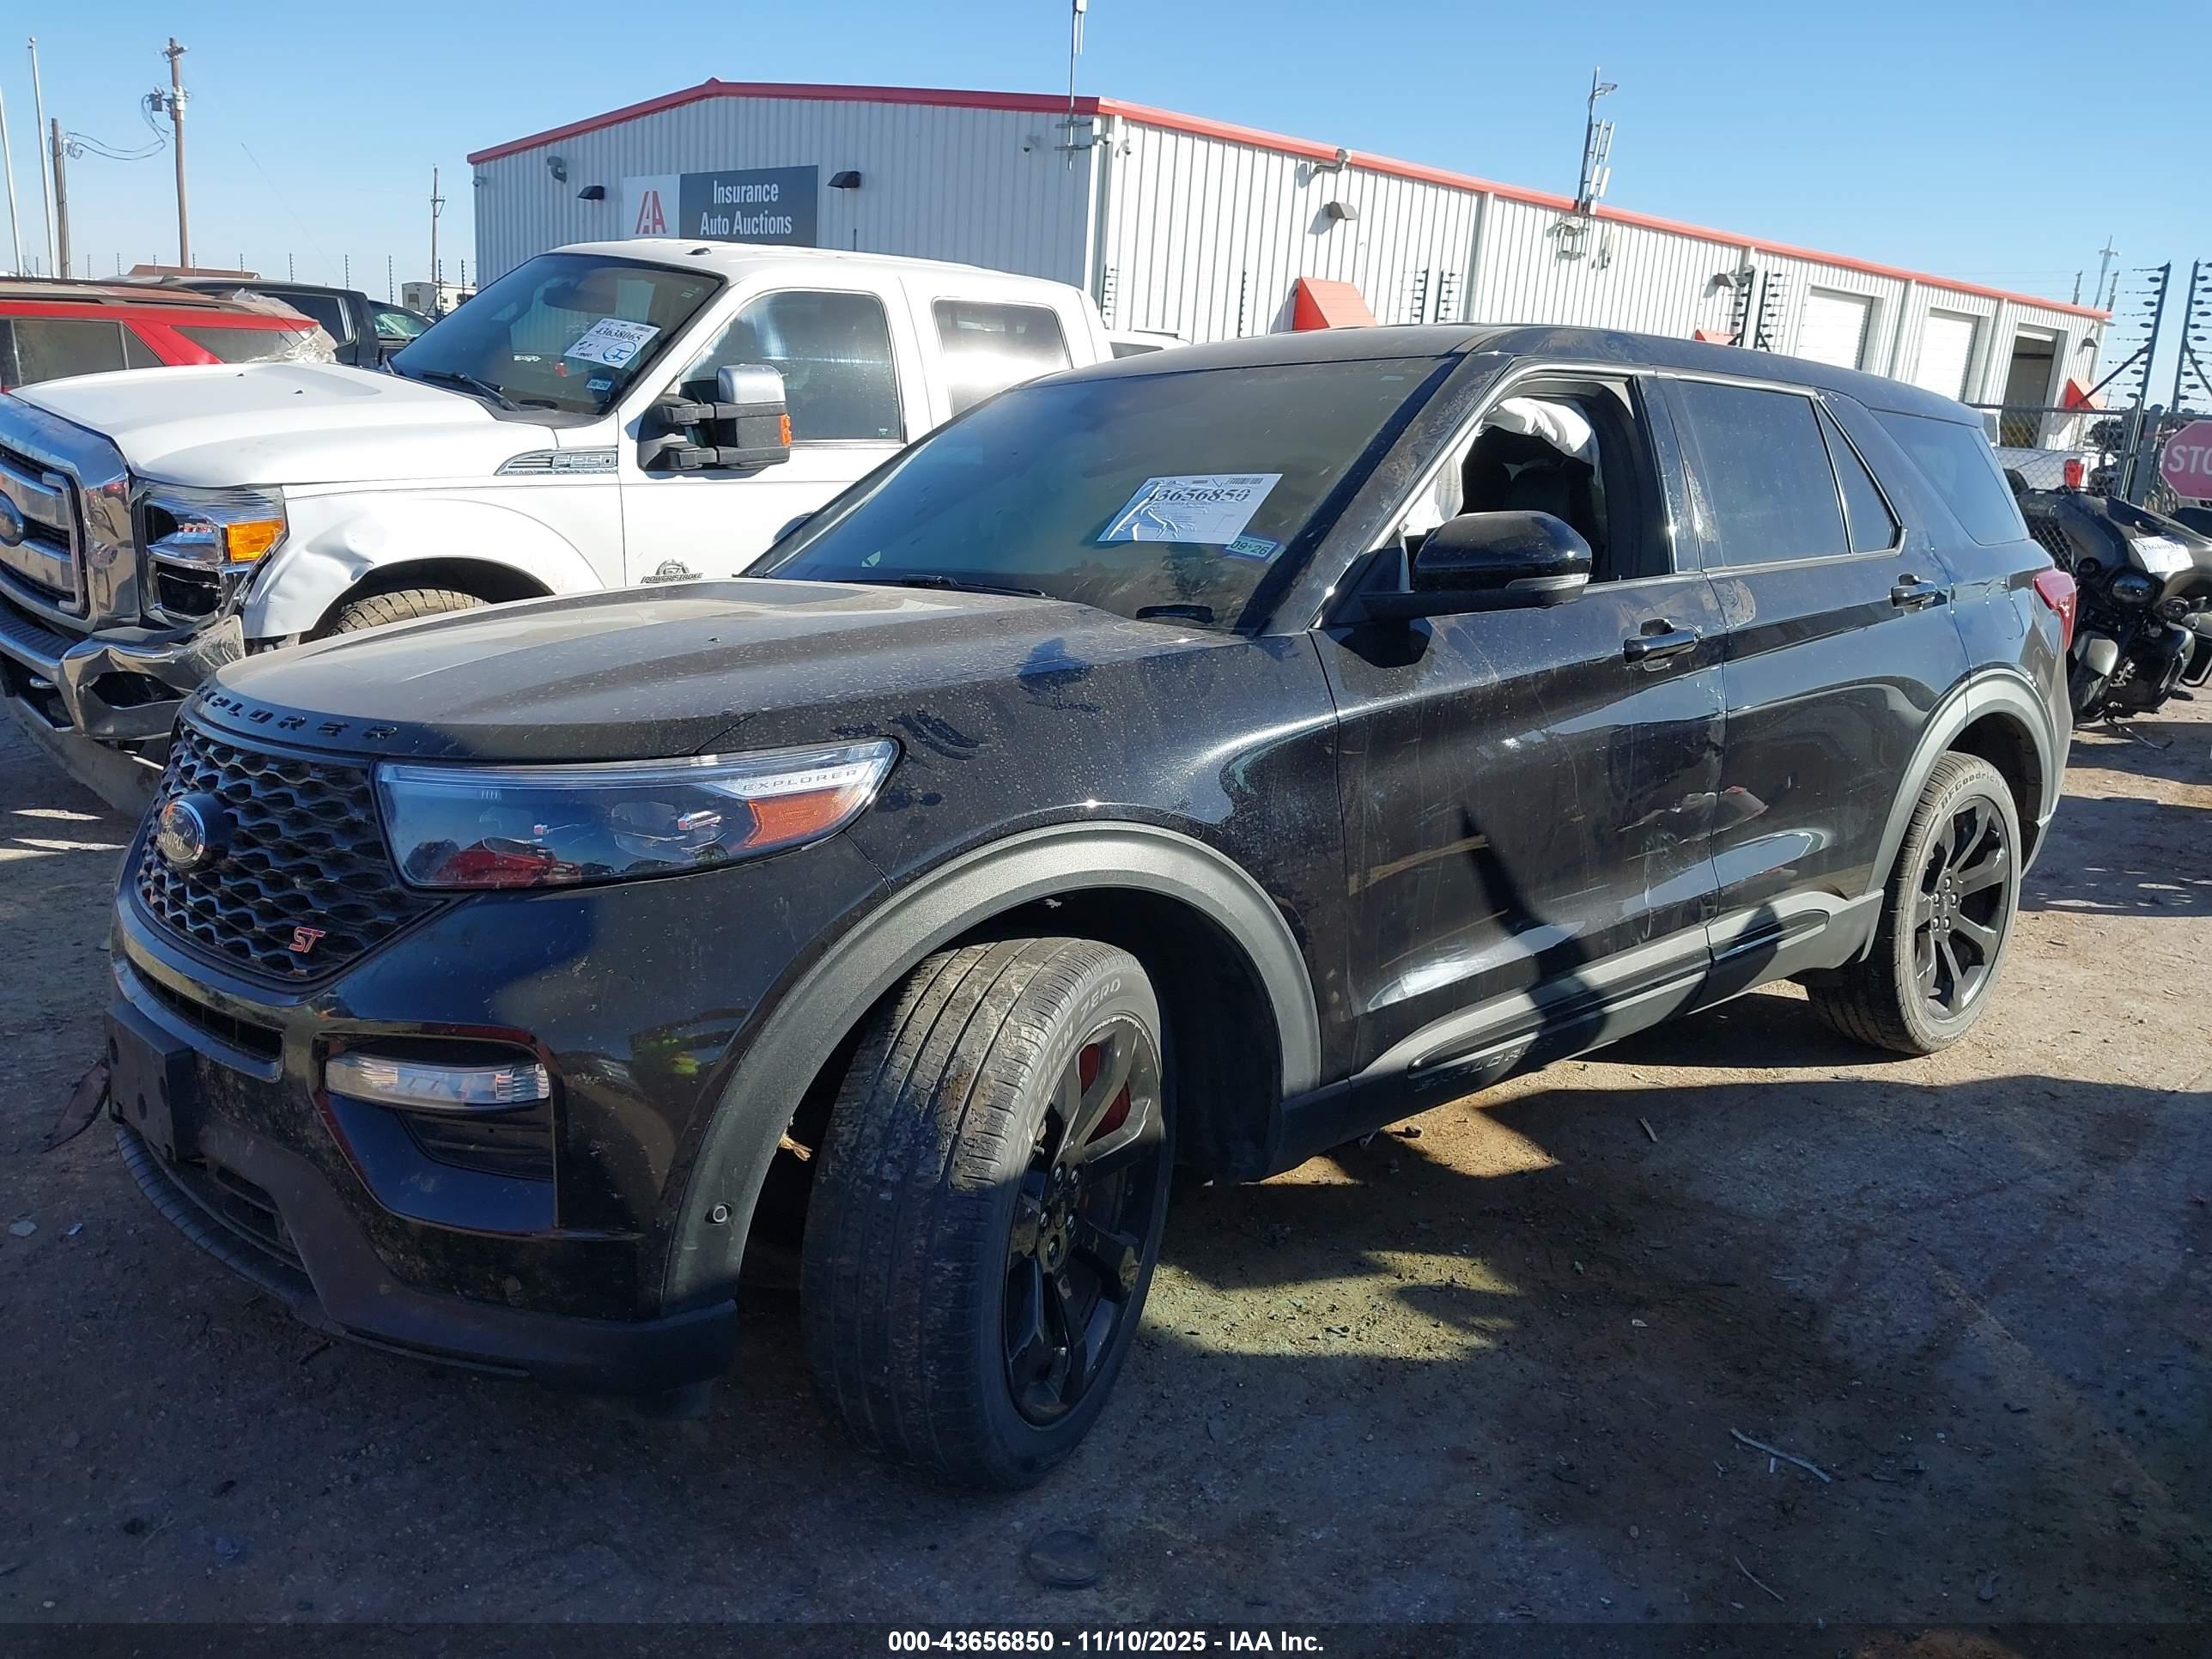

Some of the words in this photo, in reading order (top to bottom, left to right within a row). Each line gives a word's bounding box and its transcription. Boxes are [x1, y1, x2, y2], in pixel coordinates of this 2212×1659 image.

[714, 180, 779, 204] Insurance
[701, 212, 729, 235] Auto
[732, 210, 792, 235] Auctions
[743, 769, 859, 792] EXPLORER
[288, 926, 326, 953] ST
[1080, 977, 1121, 1018] ZERO
